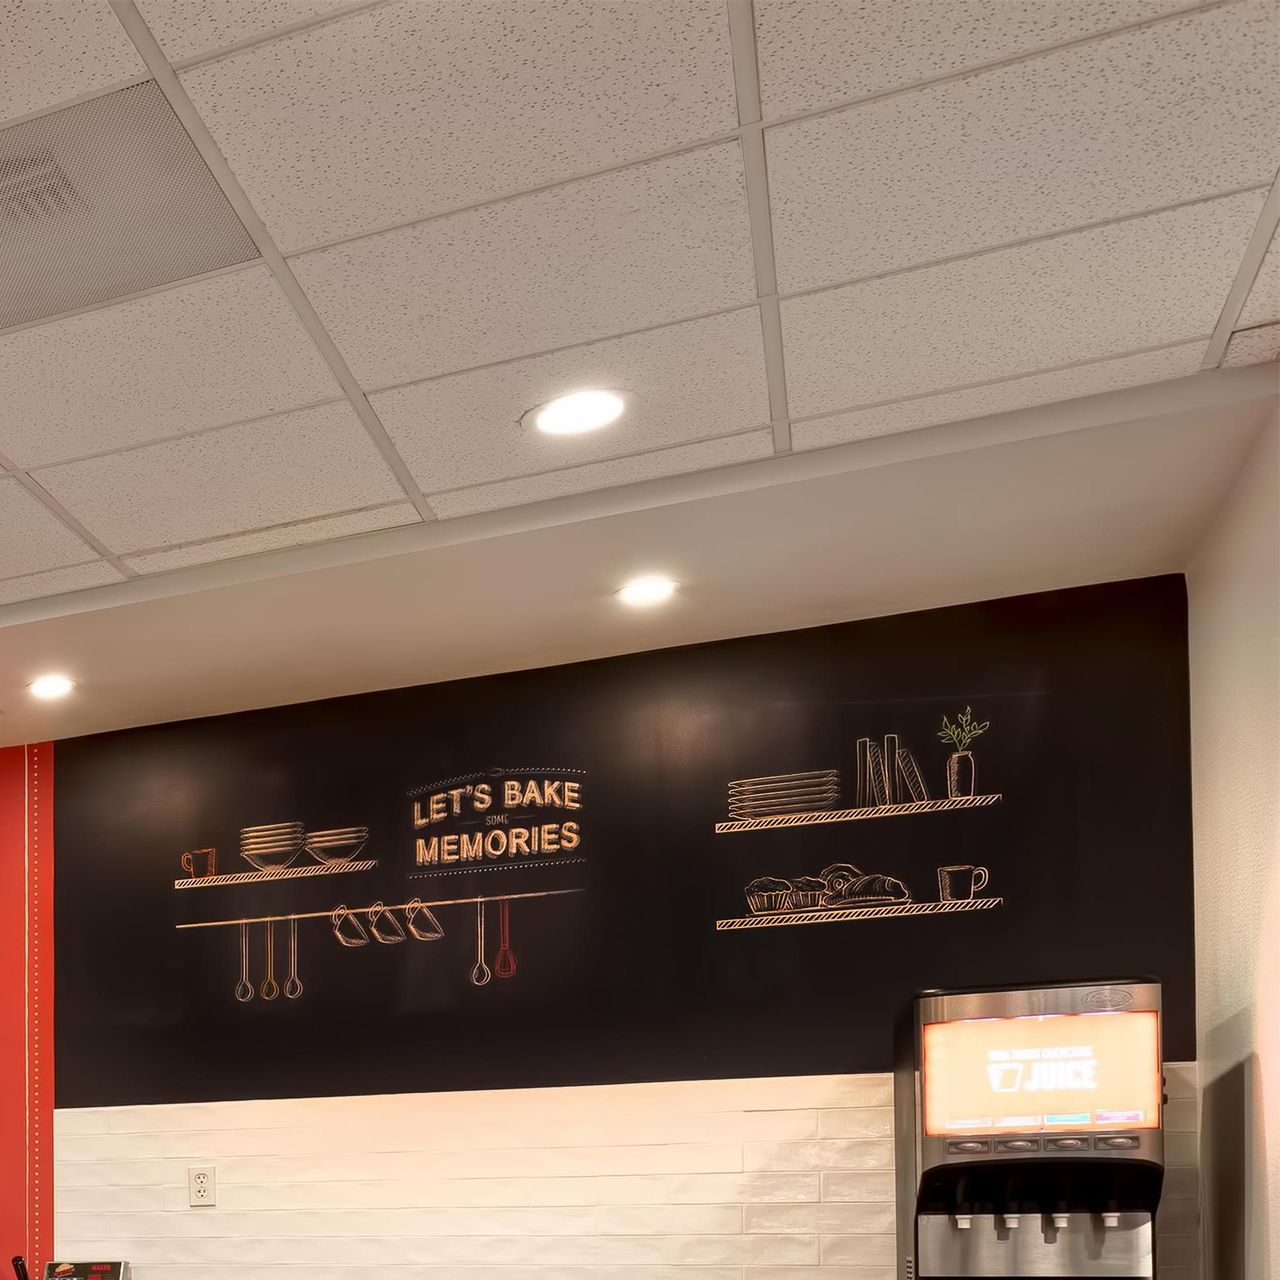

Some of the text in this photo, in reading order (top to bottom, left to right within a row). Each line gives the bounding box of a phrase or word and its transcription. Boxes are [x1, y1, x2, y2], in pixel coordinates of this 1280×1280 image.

[413, 779, 583, 829] LET'S BAKE
[485, 813, 509, 826] SOME
[415, 821, 581, 866] MEMORIES
